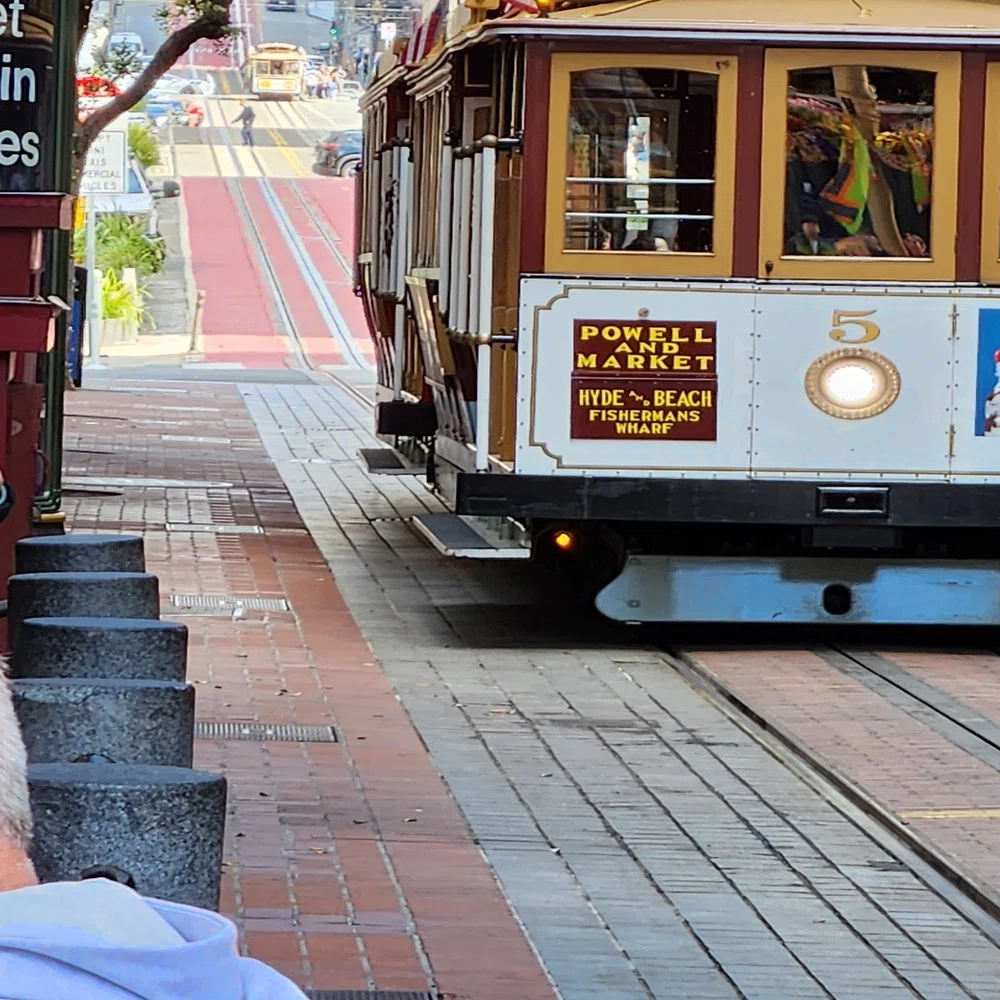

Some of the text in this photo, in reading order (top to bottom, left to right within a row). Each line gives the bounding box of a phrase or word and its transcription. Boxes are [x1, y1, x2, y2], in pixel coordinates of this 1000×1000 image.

[580, 325, 713, 342] POWELL
[829, 309, 880, 343] 5
[614, 342, 680, 354] AND
[577, 353, 714, 370] MARKET
[578, 389, 625, 406] HYDE
[653, 390, 713, 407] BEACH
[589, 410, 701, 422] FISHERMANS
[615, 422, 674, 434] WHARF
